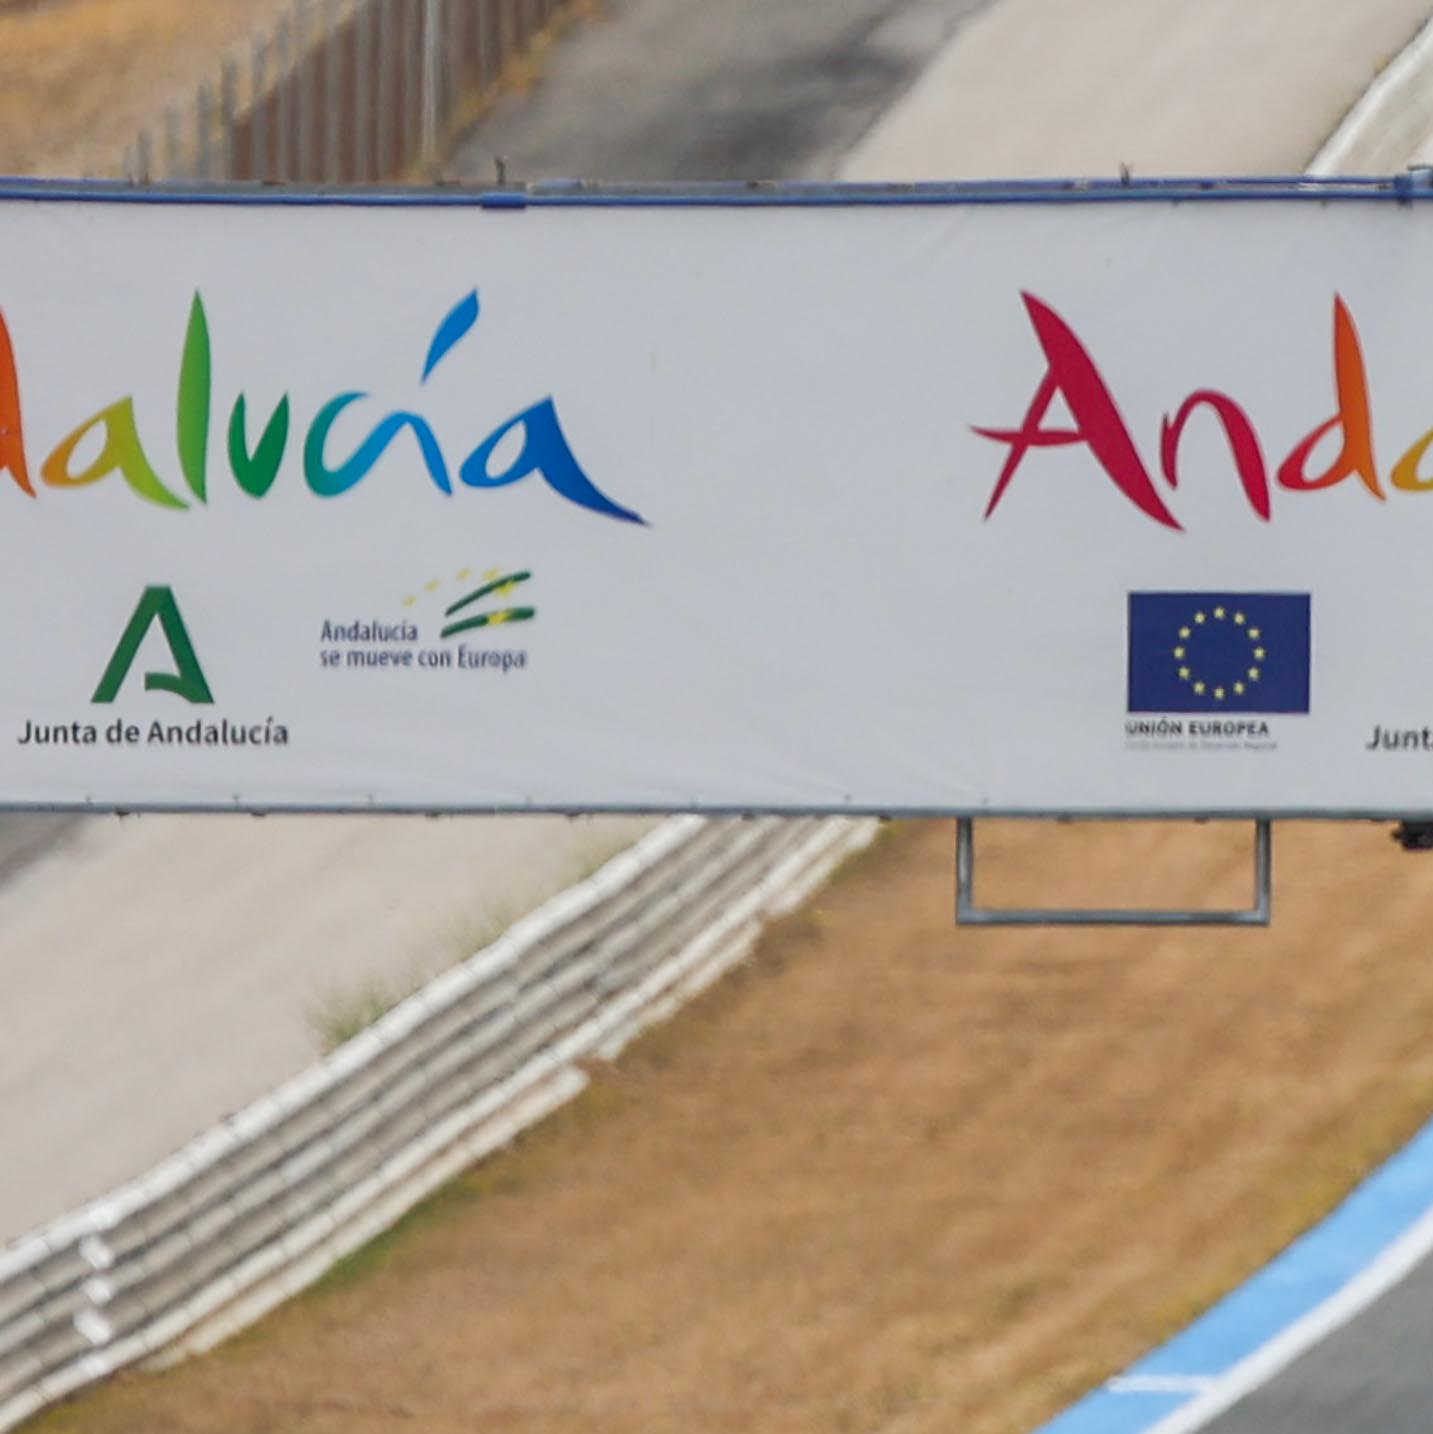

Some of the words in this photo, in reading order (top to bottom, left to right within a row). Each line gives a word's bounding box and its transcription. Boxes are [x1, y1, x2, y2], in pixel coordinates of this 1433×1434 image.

[320, 651, 340, 667] se
[347, 651, 412, 668] mueve
[418, 650, 451, 668] con
[458, 645, 527, 672] Europa
[17, 720, 97, 745] Junta
[105, 718, 140, 745] de
[147, 716, 289, 746] Andalucía
